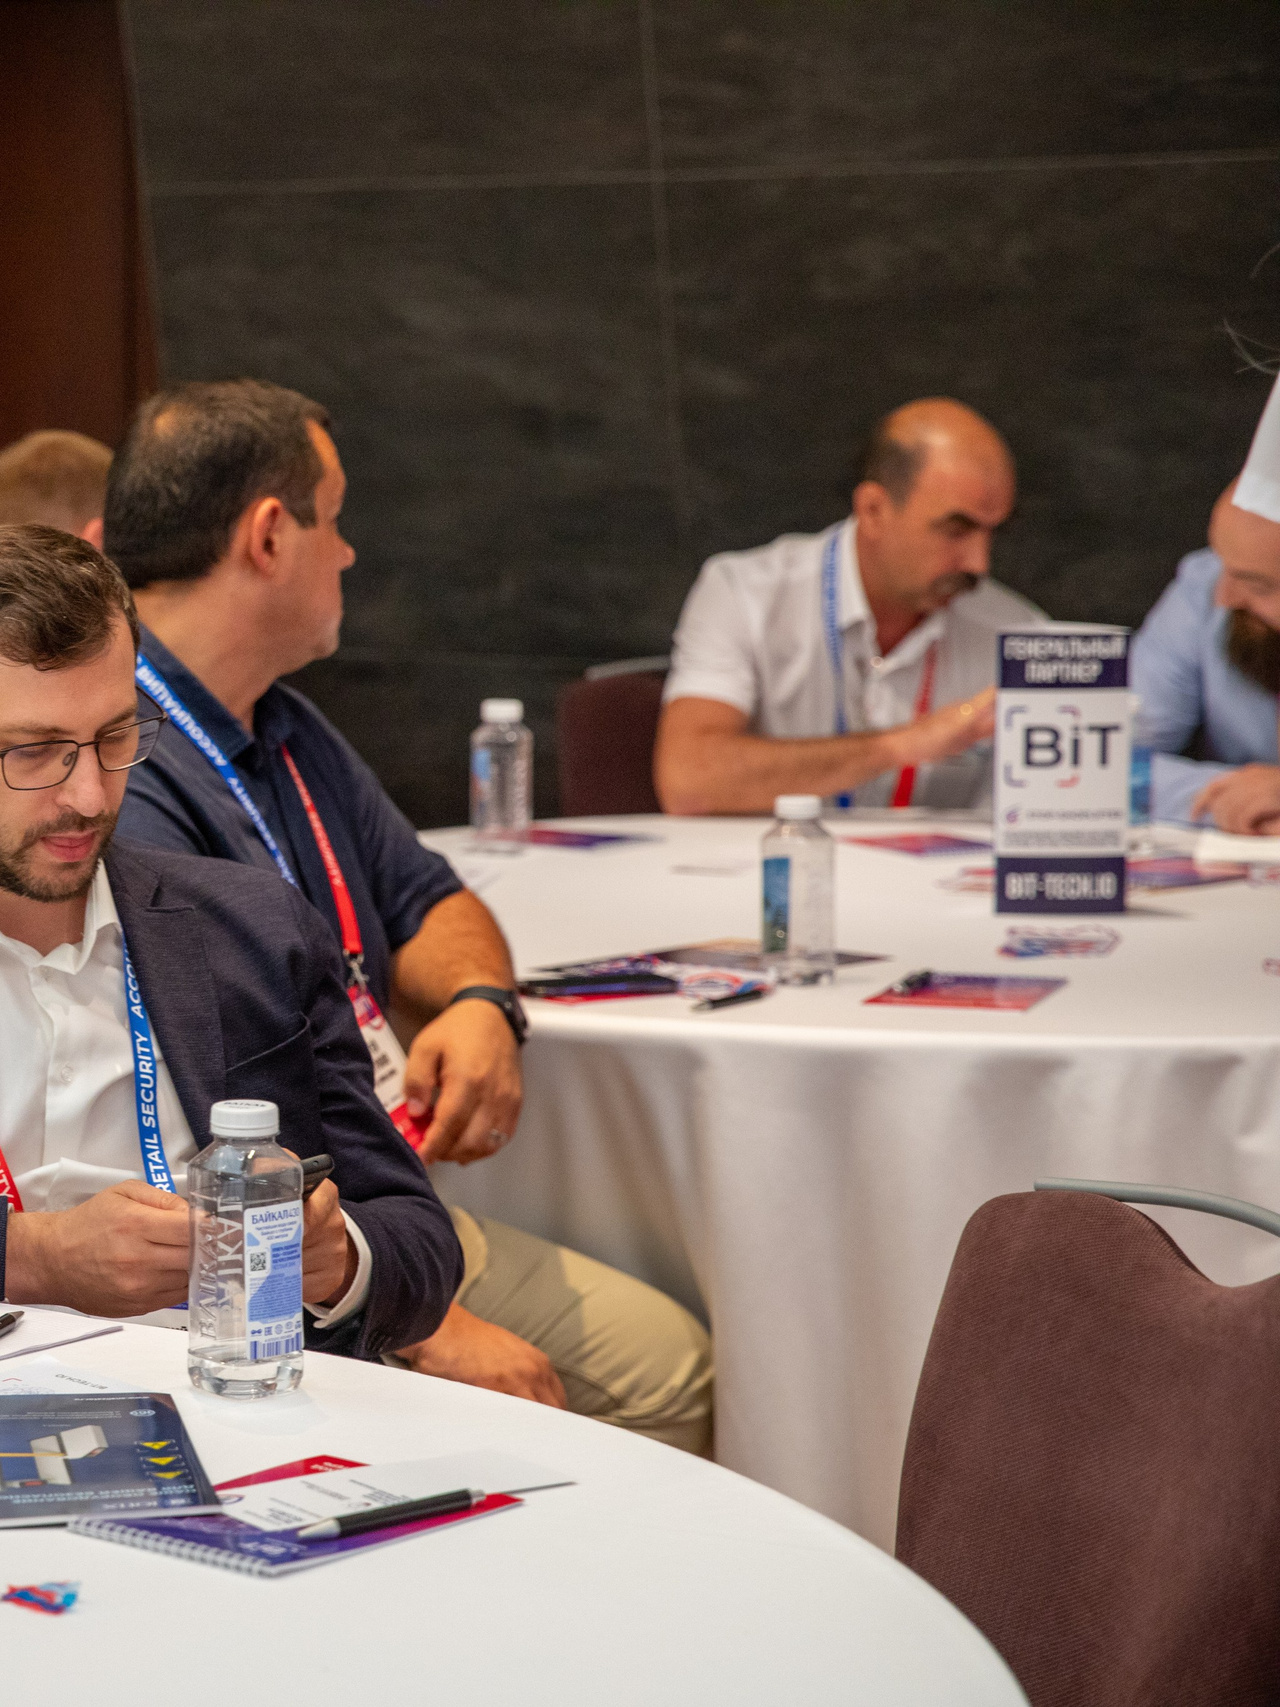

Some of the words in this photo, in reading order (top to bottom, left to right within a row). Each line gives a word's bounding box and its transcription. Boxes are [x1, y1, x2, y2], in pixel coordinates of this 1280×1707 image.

[135, 665, 227, 767] АССОЦИАЦИЯ
[135, 1031, 157, 1128] SECURITY
[146, 1133, 172, 1193] RETAIL
